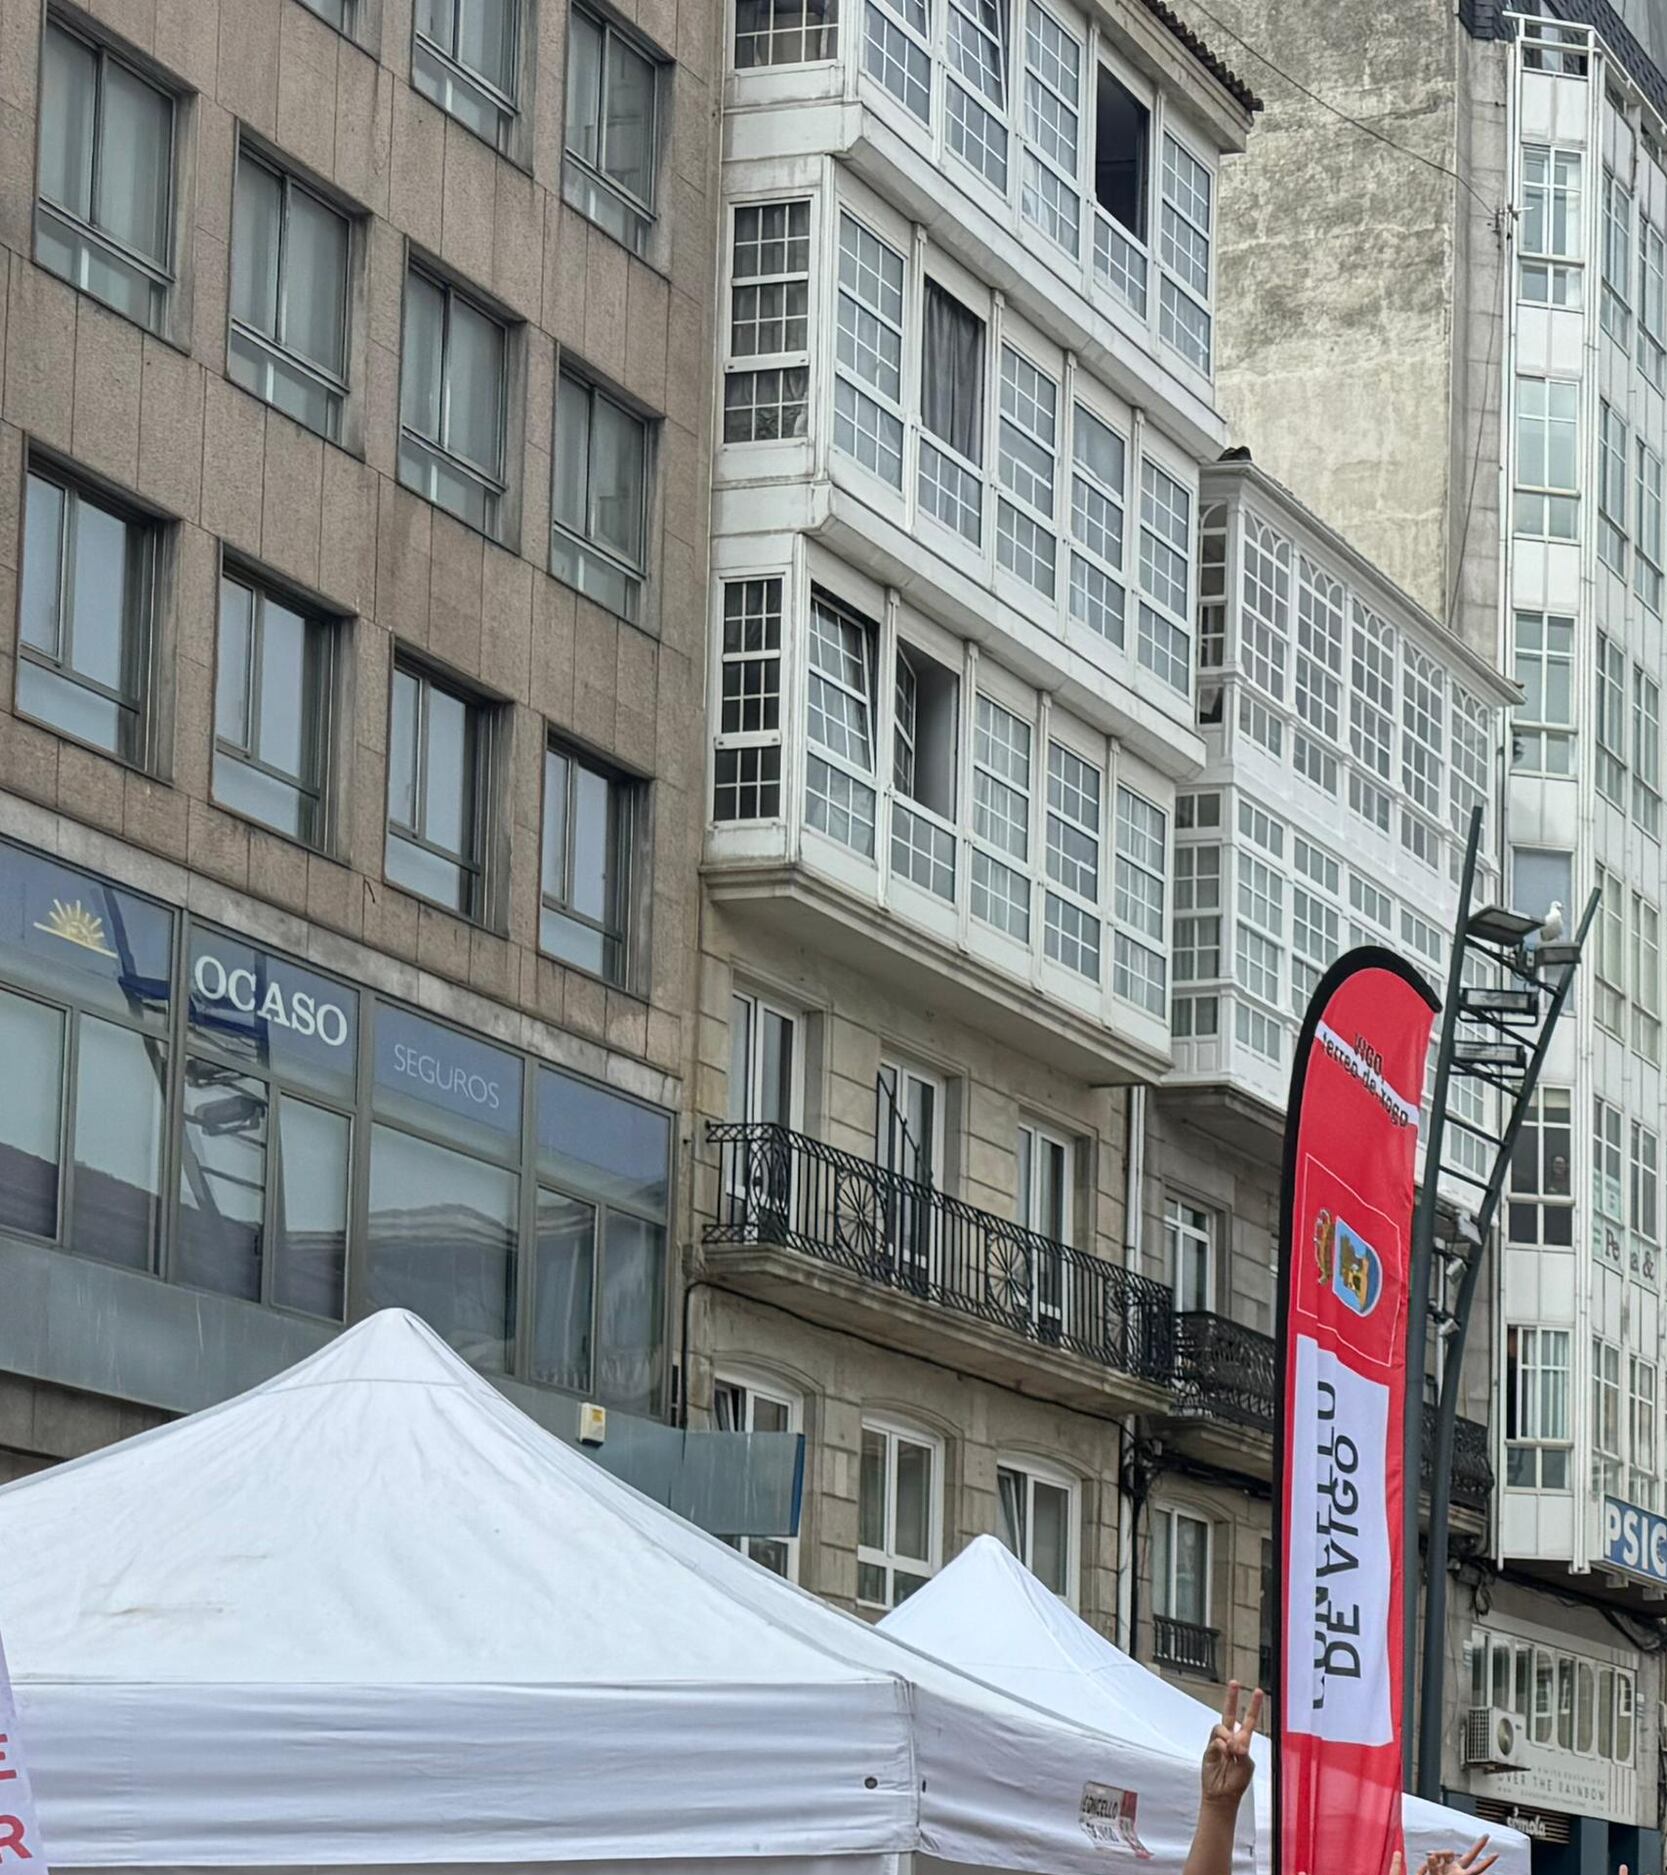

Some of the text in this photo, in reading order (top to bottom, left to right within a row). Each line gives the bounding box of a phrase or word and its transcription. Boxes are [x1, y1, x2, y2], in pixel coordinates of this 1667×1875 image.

[194, 954, 349, 1047] OCASO
[392, 1041, 501, 1110] SEGUROS
[1325, 1434, 1362, 1679] DE VIGO
[1533, 1775, 1552, 1792] THE
